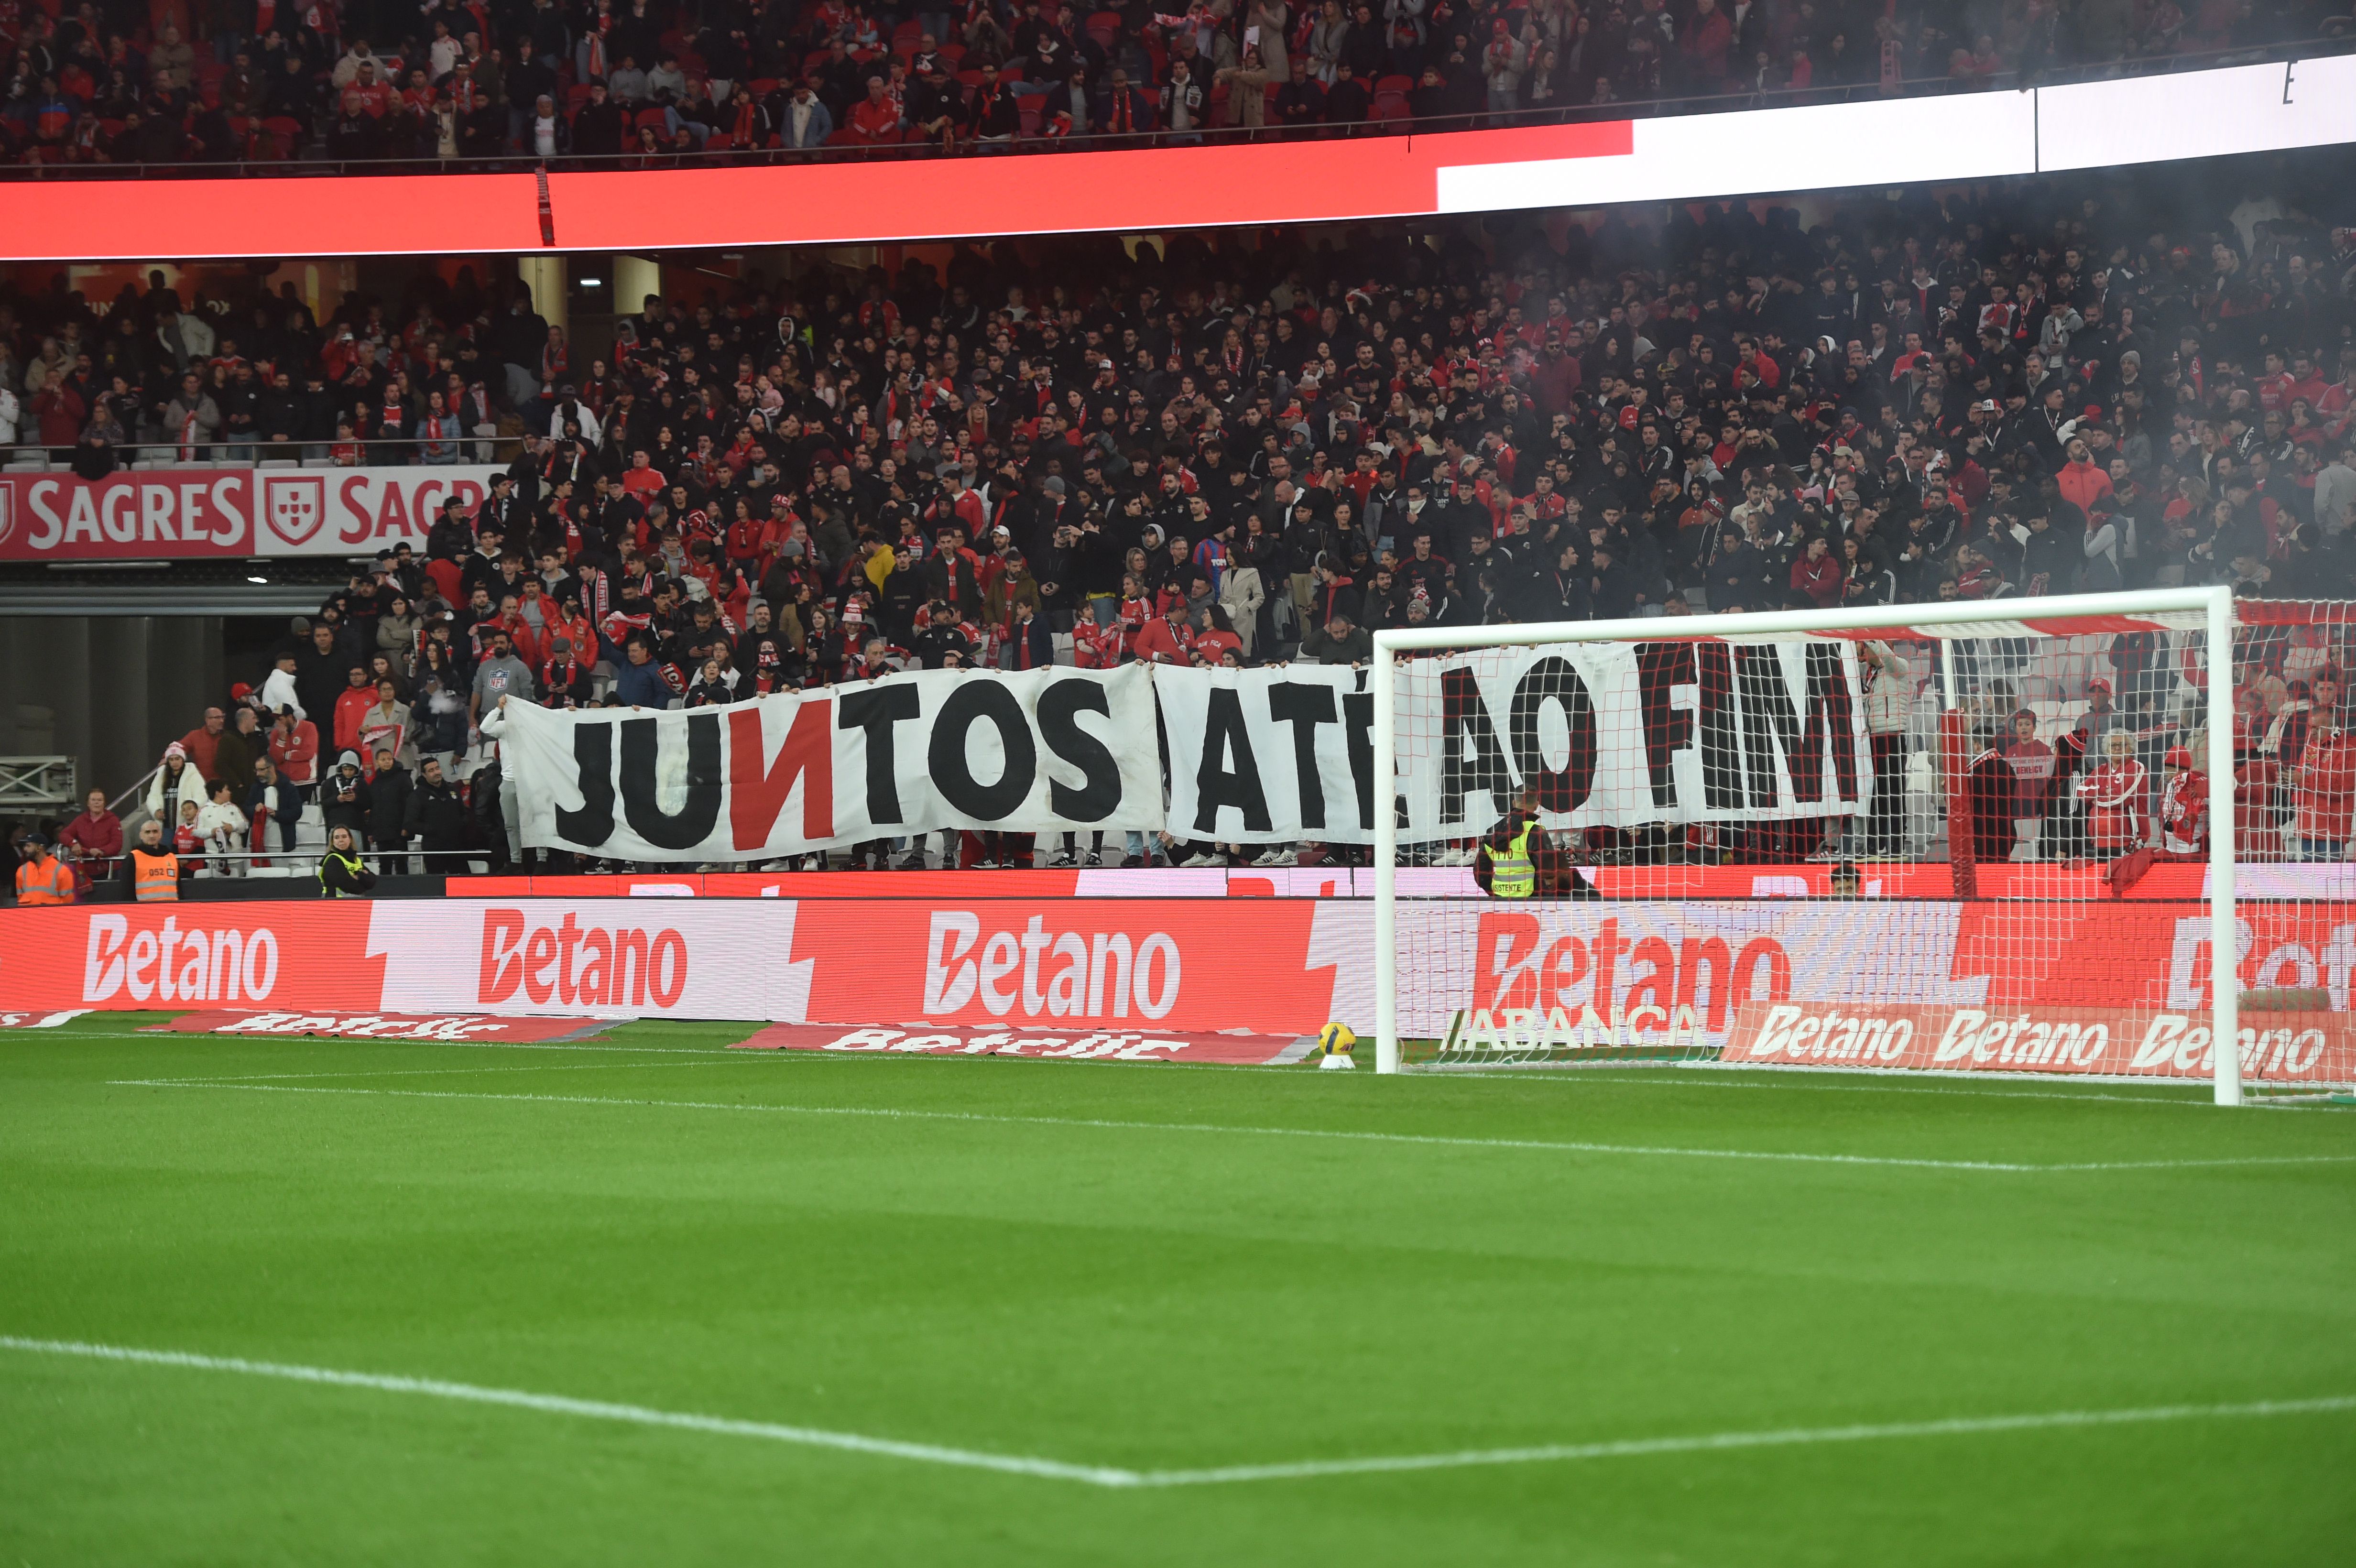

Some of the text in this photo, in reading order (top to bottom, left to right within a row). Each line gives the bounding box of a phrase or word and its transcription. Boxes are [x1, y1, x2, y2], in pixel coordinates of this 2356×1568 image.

[28, 477, 246, 549] SAGRES
[491, 677, 506, 688] NFL
[556, 677, 1122, 851] JUNTOS
[1440, 655, 1597, 823] AO
[1633, 642, 1858, 809] FIM
[82, 914, 279, 1002] Betano
[478, 909, 687, 1008] Betano
[922, 911, 1181, 1019] Betano
[1472, 912, 1791, 1033] Betano
[1749, 1005, 1914, 1062] Betano
[1933, 1009, 2109, 1067] Betano
